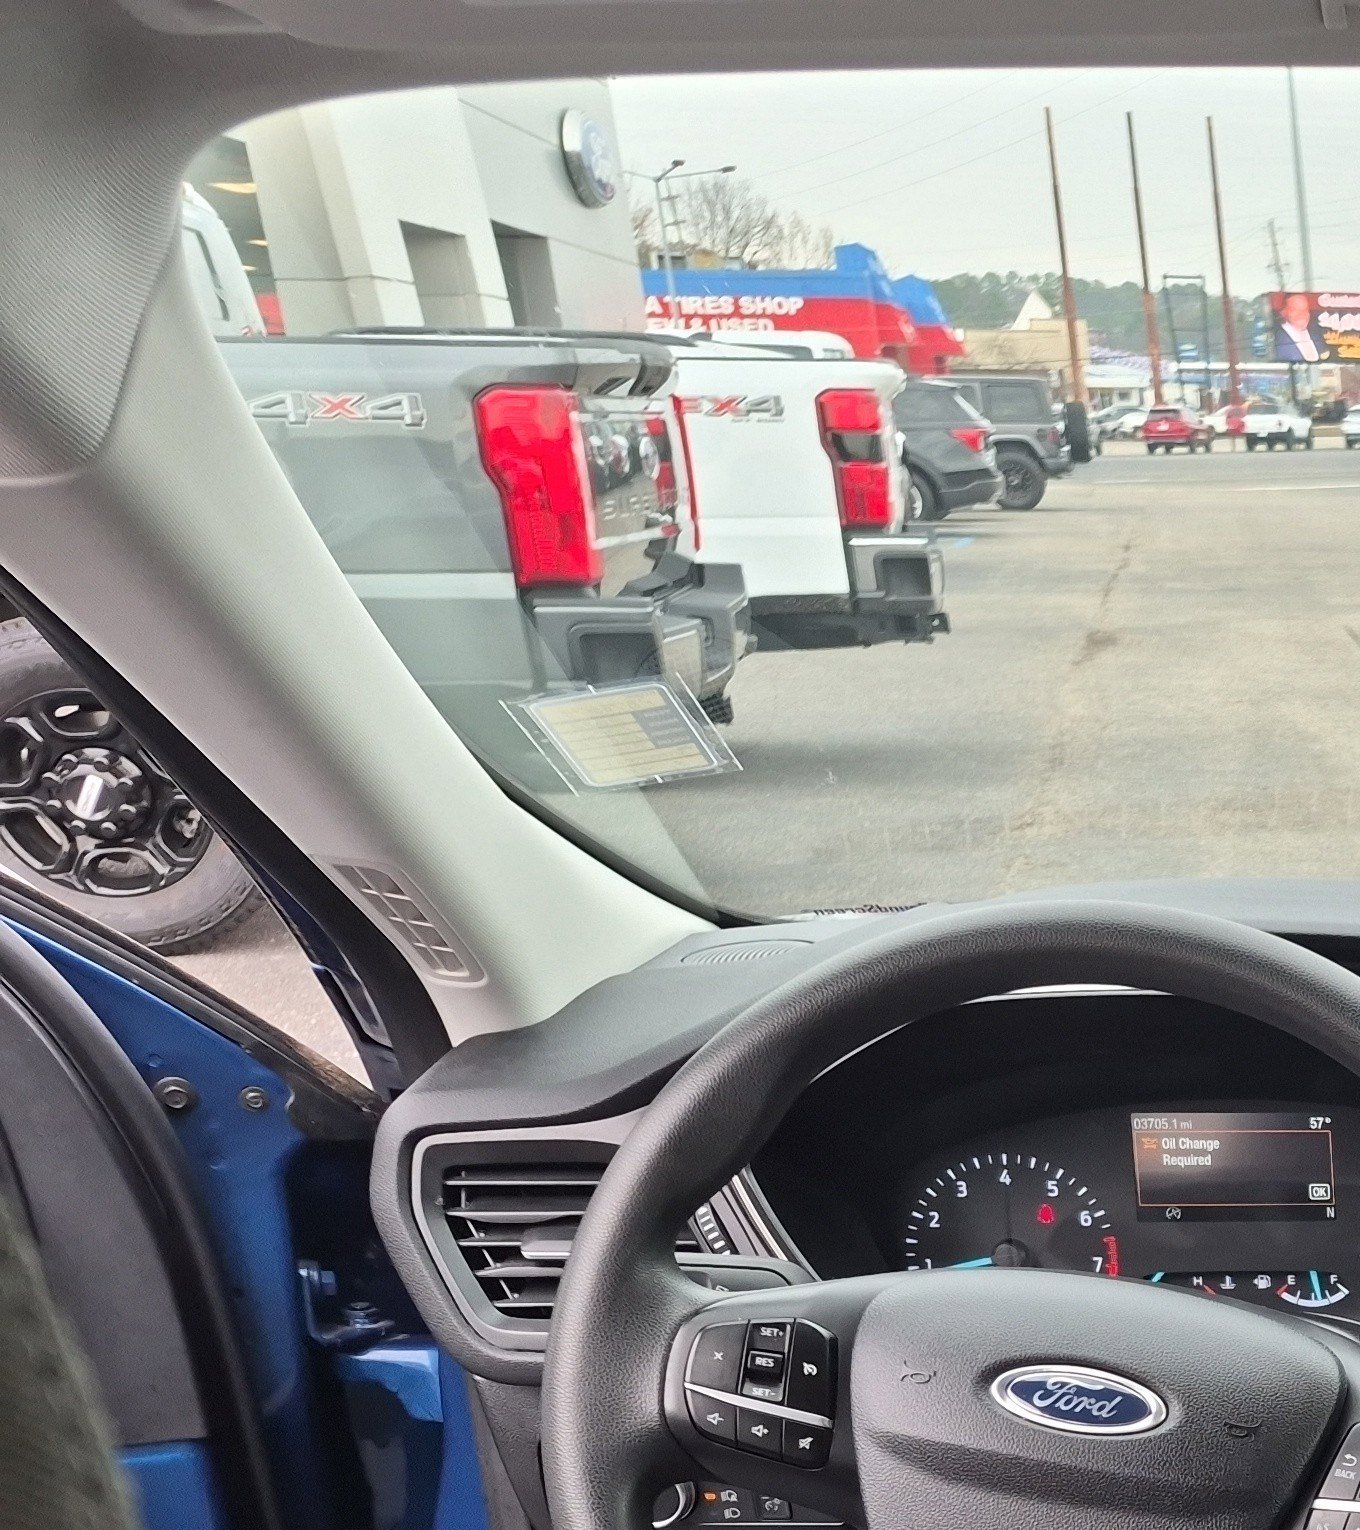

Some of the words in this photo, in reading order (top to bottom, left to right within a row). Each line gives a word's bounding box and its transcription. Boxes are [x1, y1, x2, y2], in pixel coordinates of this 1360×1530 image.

[663, 296, 734, 315] TIRES
[738, 296, 804, 316] SHOP
[1180, 1118, 1193, 1130] mi
[1161, 1137, 1175, 1150] Oil
[1178, 1137, 1220, 1151] Change
[1163, 1154, 1212, 1168] Required
[999, 1168, 1011, 1185] 4
[956, 1180, 968, 1198] 3
[1047, 1180, 1059, 1197] 5
[1312, 1186, 1327, 1198] OK
[1080, 1210, 1092, 1227] 6
[1327, 1207, 1335, 1218] N
[928, 1211, 941, 1228] 2
[1092, 1256, 1103, 1273] 7
[1193, 1276, 1203, 1286] H
[1287, 1275, 1296, 1285] E
[1330, 1274, 1339, 1285] F
[760, 1326, 785, 1337] SET+
[755, 1356, 775, 1367] RES
[751, 1387, 776, 1397] SET-
[1032, 1376, 1123, 1418] Ford
[1334, 1469, 1357, 1480] BACK
